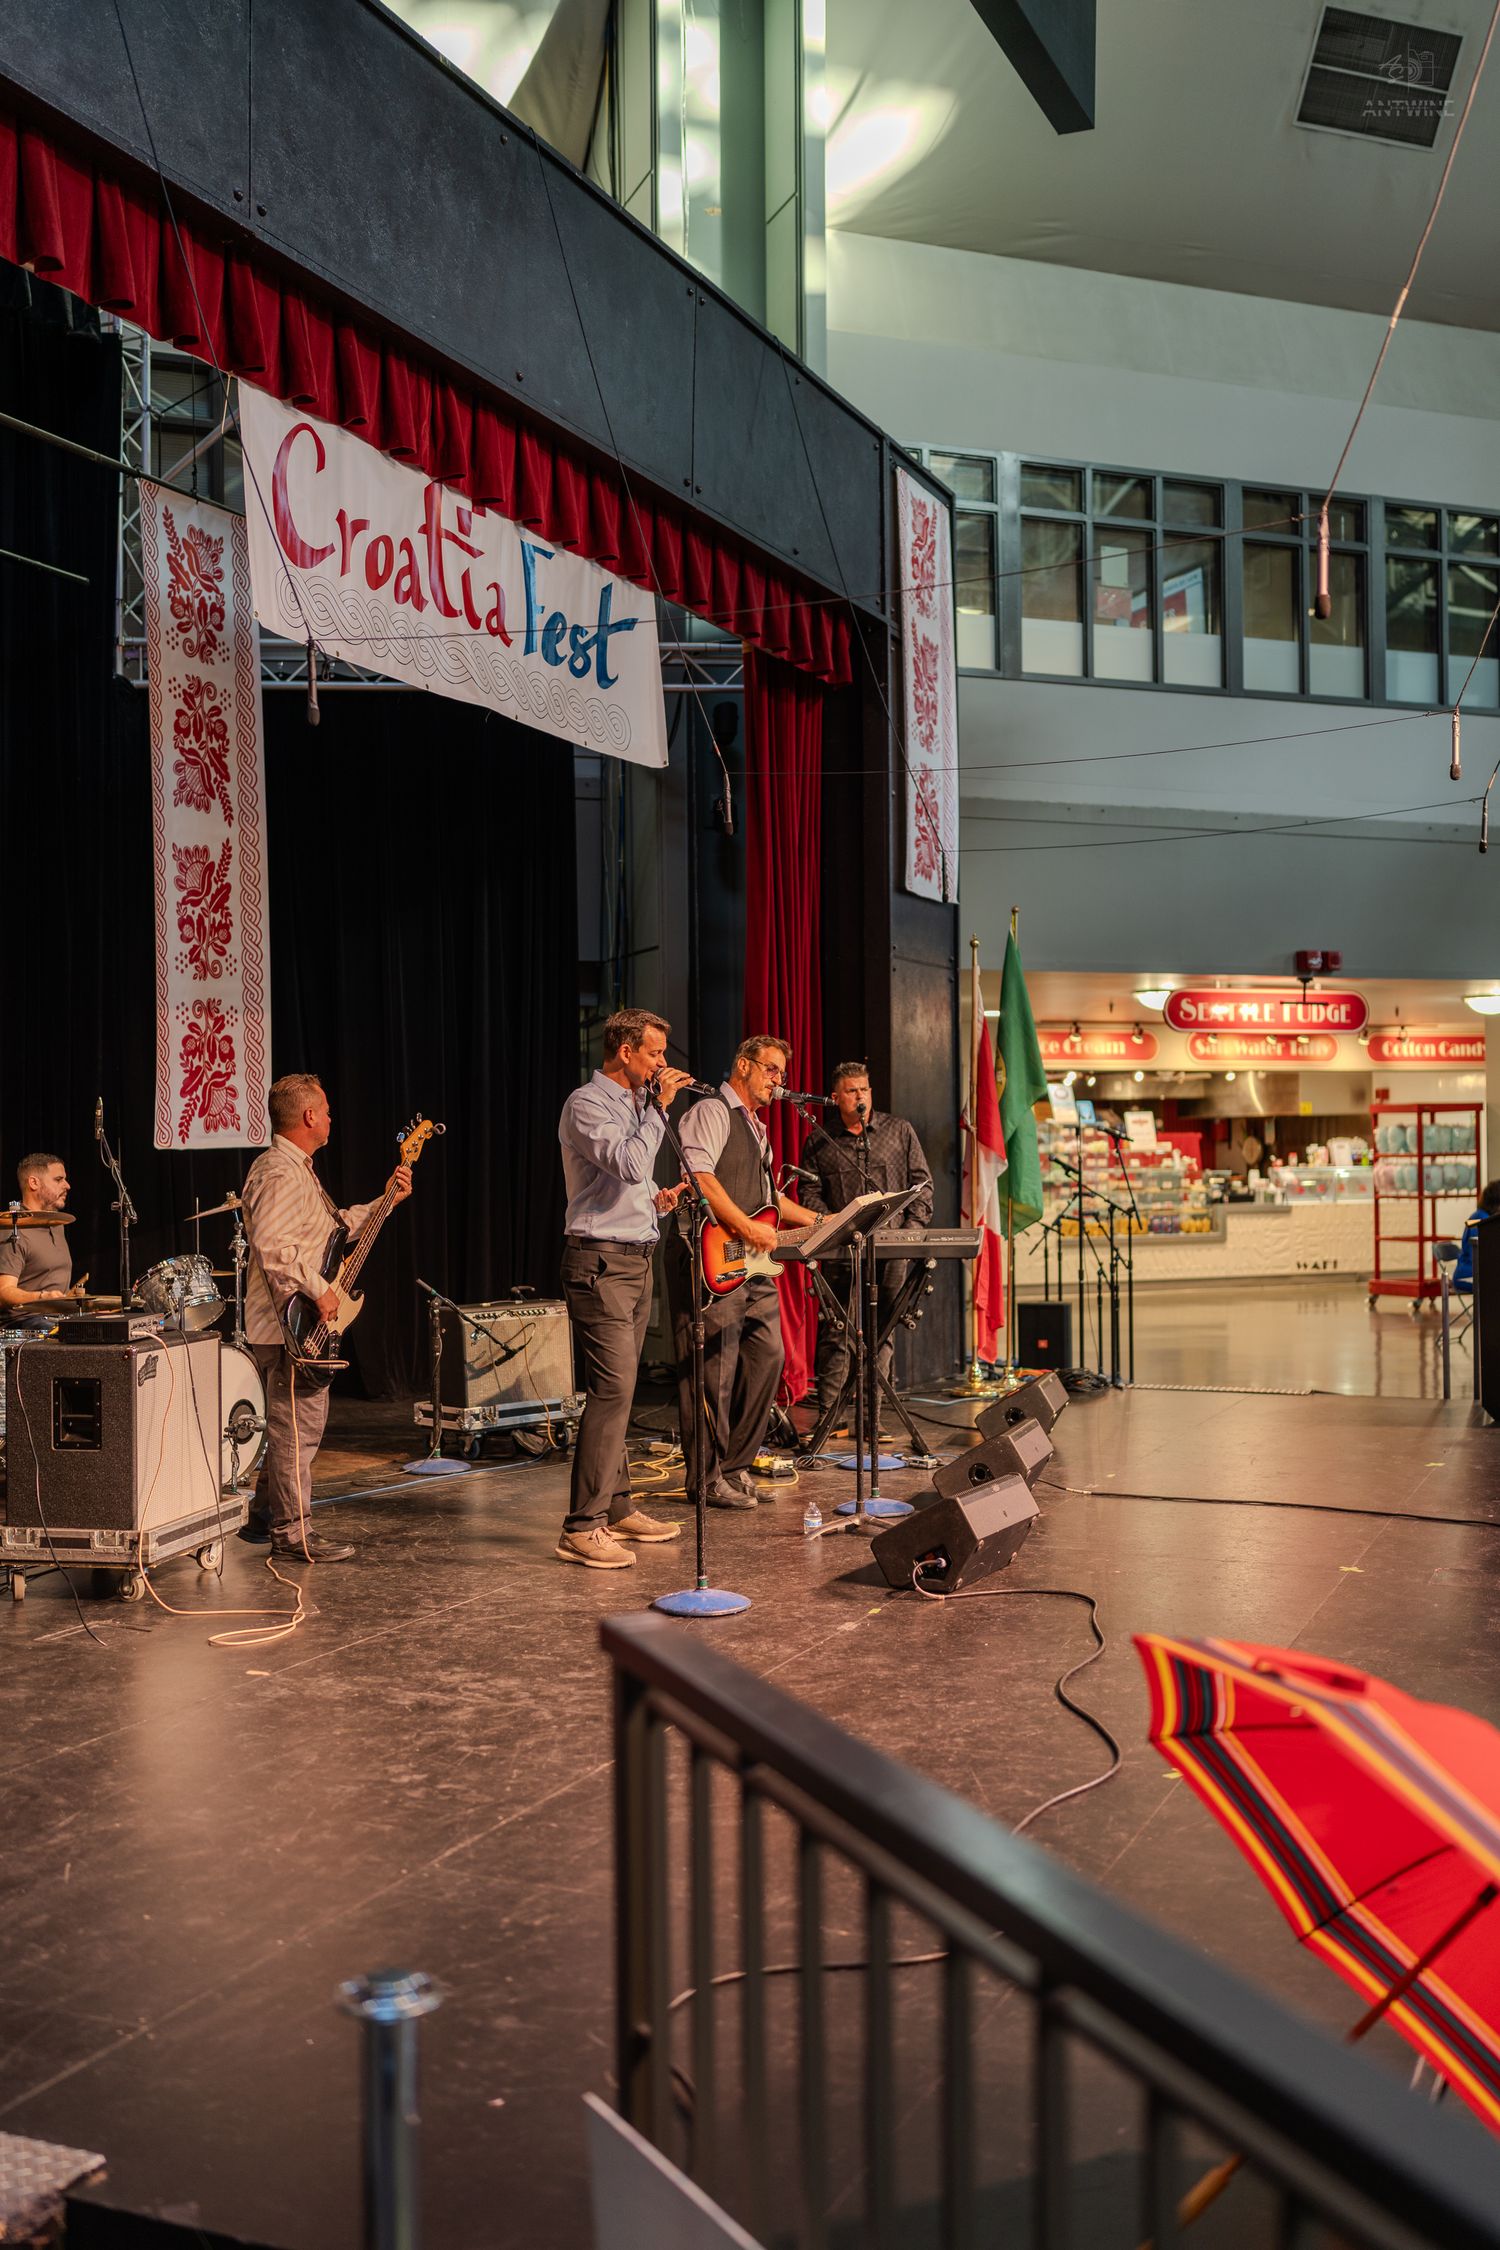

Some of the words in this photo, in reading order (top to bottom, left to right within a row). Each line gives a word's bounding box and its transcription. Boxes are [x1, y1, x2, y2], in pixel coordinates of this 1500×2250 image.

[1062, 1039, 1126, 1055] Cream
[1233, 1039, 1284, 1057] Water
[1382, 1040, 1436, 1057] Cotton
